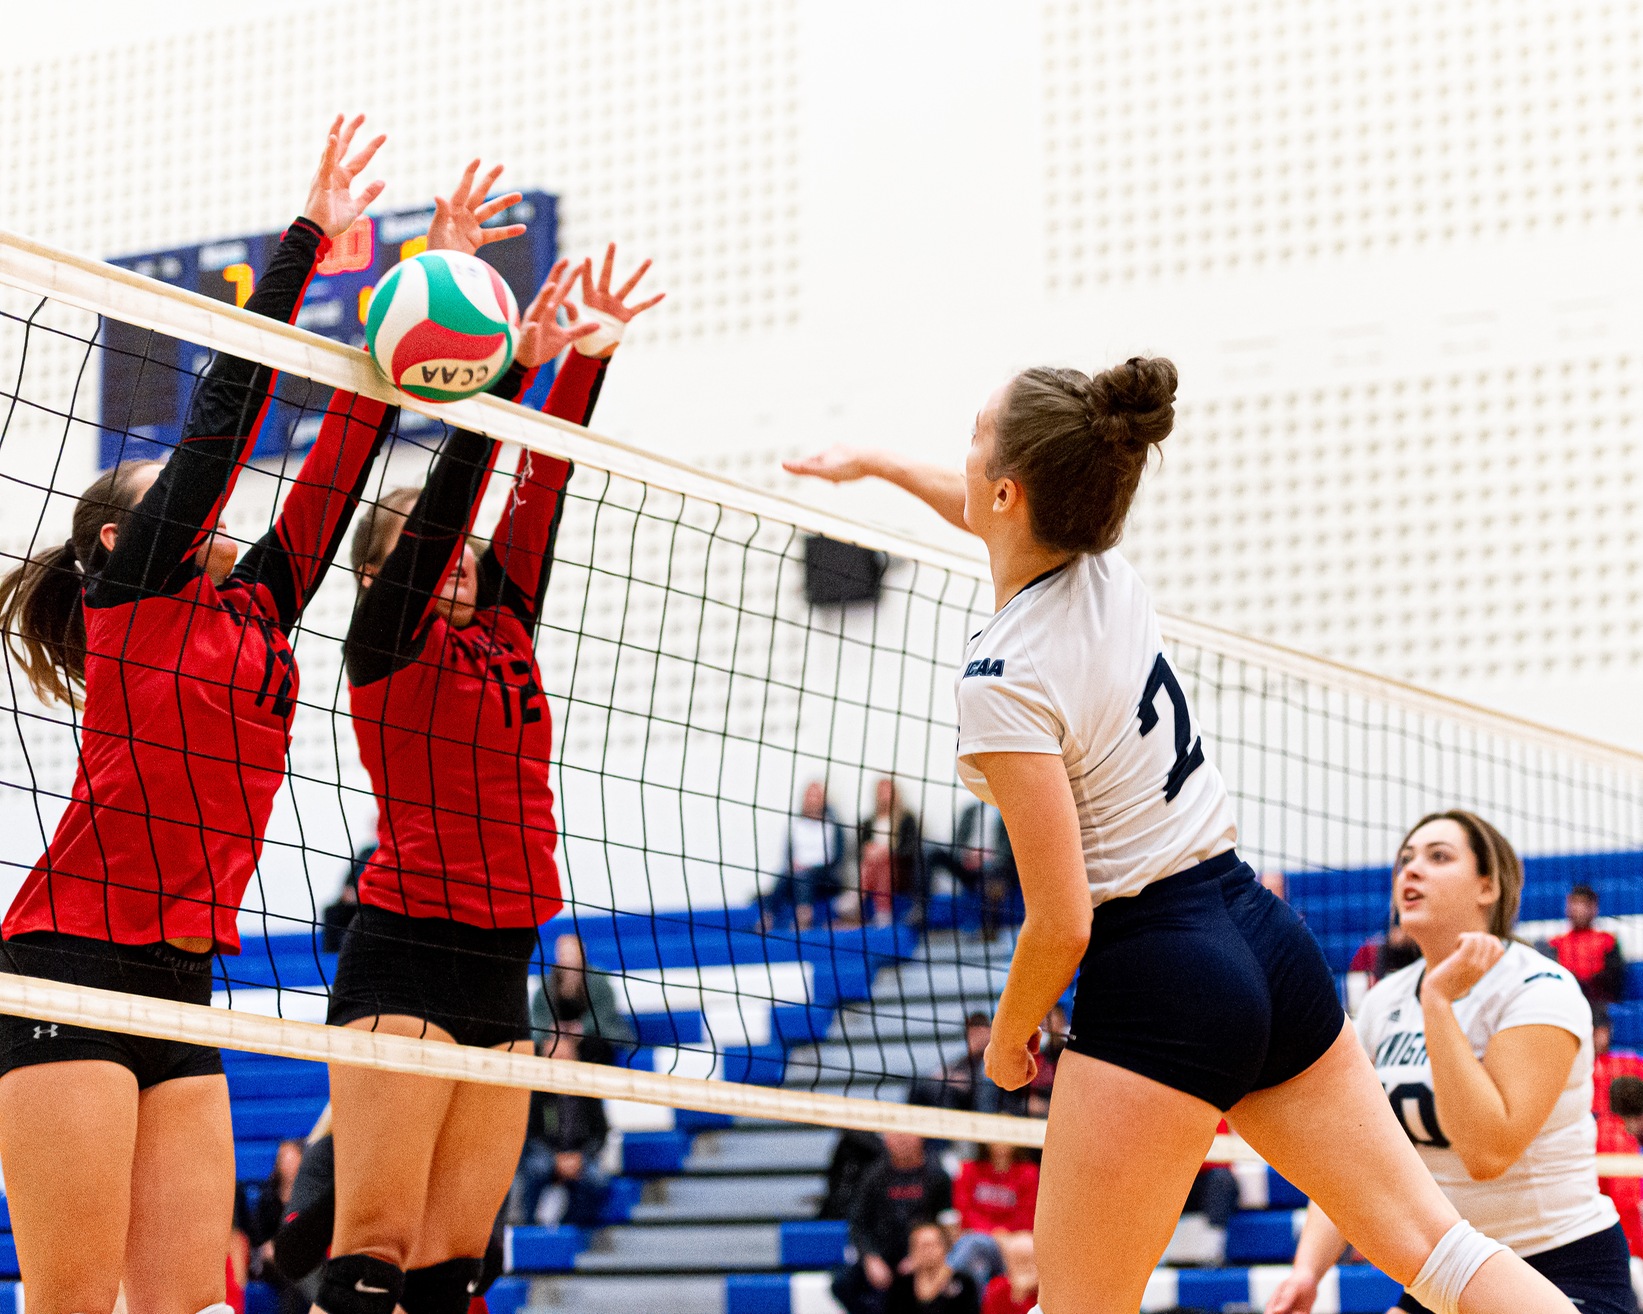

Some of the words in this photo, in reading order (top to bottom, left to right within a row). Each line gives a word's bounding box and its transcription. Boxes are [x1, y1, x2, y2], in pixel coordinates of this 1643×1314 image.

[421, 364, 489, 386] CCAA
[963, 657, 1005, 680] CAA
[490, 660, 542, 729] 12
[1137, 652, 1204, 803] 2
